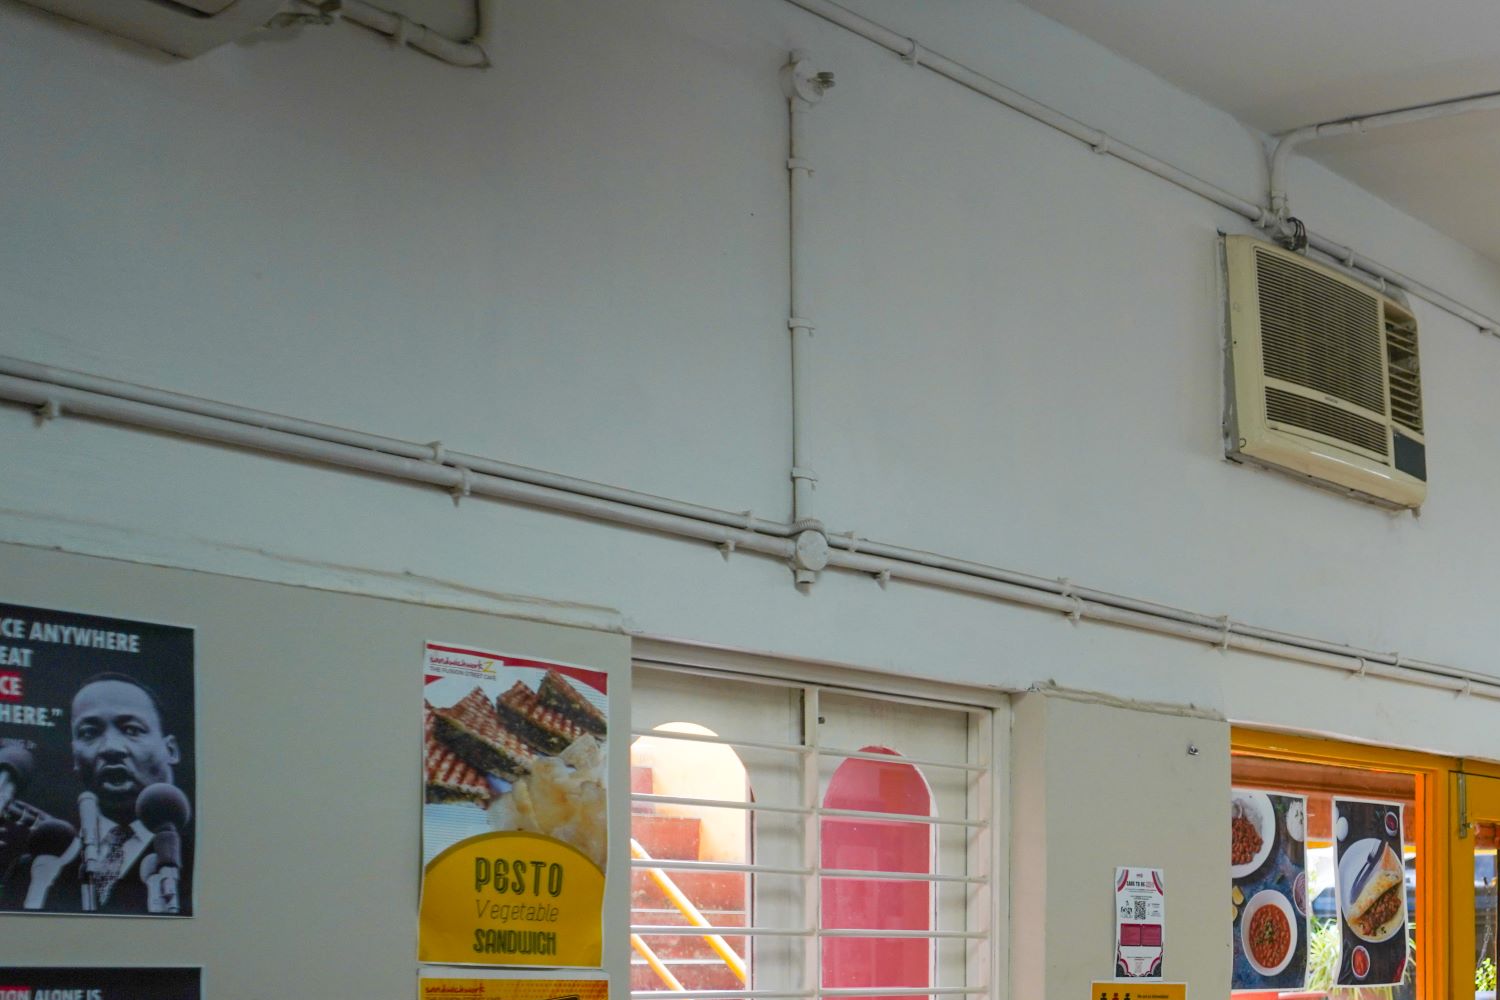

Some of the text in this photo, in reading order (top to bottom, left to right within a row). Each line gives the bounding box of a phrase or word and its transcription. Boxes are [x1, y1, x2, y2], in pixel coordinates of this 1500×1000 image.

[29, 622, 141, 653] ANYWHERE
[475, 857, 563, 897] PESTO
[475, 899, 560, 924] Vegetable
[473, 928, 556, 955] SANDWICH
